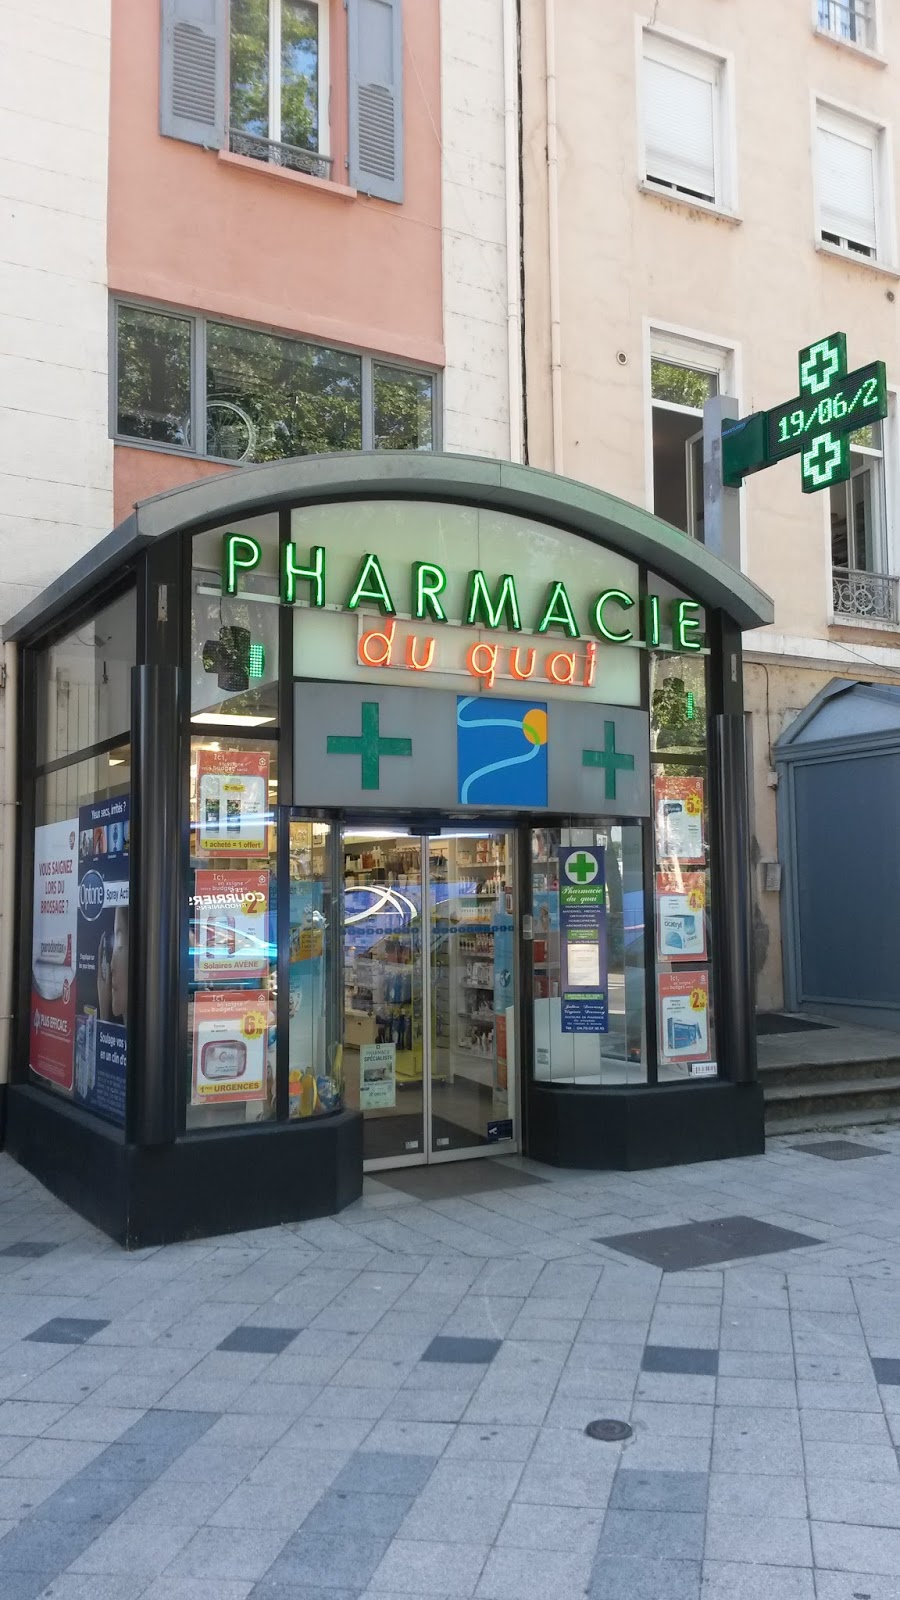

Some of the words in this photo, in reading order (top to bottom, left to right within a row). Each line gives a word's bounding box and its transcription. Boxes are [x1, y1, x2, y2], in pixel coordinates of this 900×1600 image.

[778, 377, 878, 442] 19/06/2
[222, 531, 702, 651] PHARMACIE
[358, 616, 436, 670] du
[466, 640, 597, 689] quai
[39, 862, 51, 876] VOUS
[52, 859, 73, 874] SAIGNEZ
[44, 881, 57, 895] LORS
[57, 880, 65, 894] DU
[561, 886, 602, 895] Pharmacie
[80, 884, 103, 910] Optone
[106, 889, 118, 902] Spray
[580, 894, 598, 904] quai
[40, 900, 65, 914] BROSSAGE
[203, 962, 233, 970] Solaires
[692, 992, 700, 1008] 2
[41, 1013, 50, 1027] PLUS
[50, 1016, 68, 1034] EFFICACE
[244, 1015, 256, 1035] 6
[99, 1031, 116, 1047] Soulage
[116, 1037, 124, 1047] vos
[100, 1051, 106, 1060] en
[106, 1052, 111, 1062] un
[111, 1052, 119, 1064] clin
[214, 1082, 260, 1093] URGENCES
